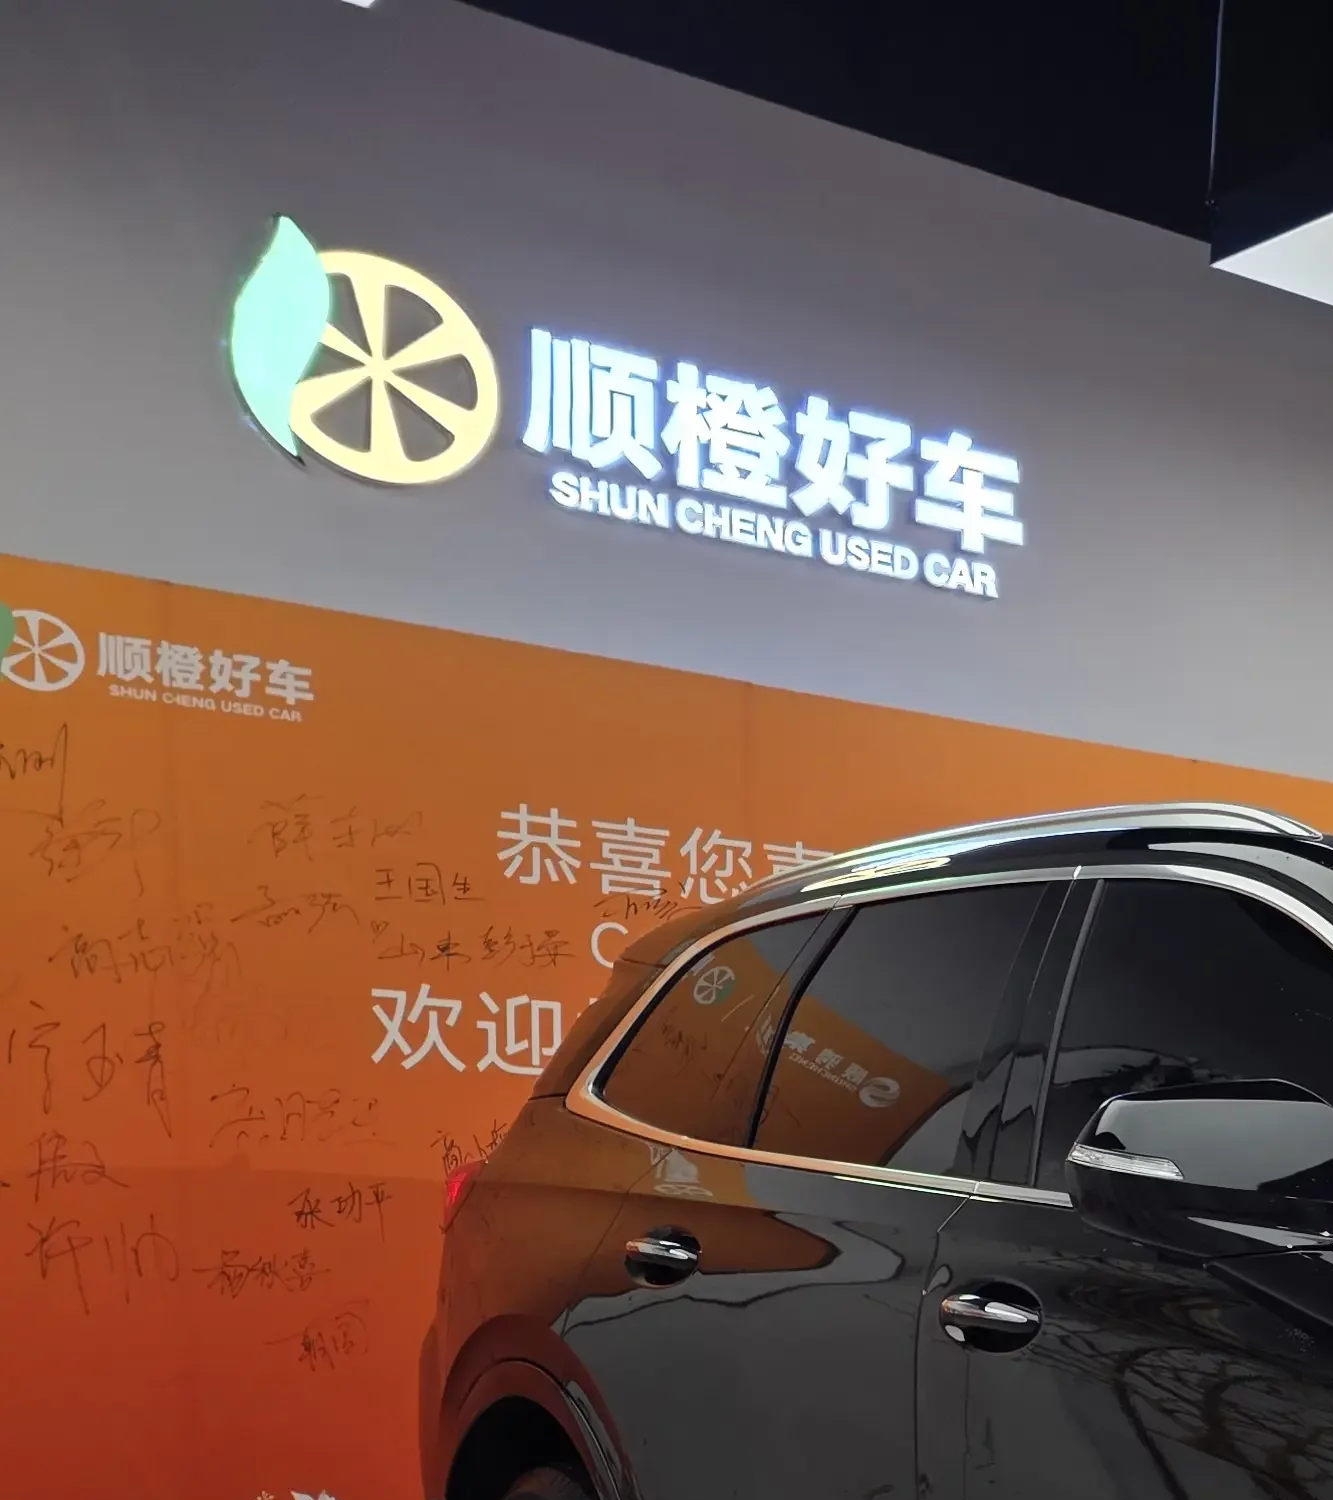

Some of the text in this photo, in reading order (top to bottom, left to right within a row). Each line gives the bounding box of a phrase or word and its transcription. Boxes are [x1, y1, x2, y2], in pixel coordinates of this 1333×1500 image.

[522, 327, 1024, 553] 顺橙好车
[549, 472, 999, 599] SHUN CHENG USED CAR
[96, 631, 314, 705] 顺橙好车
[109, 684, 302, 722] SHUN CHENG USED CAR
[371, 983, 597, 1076] 欢迎
